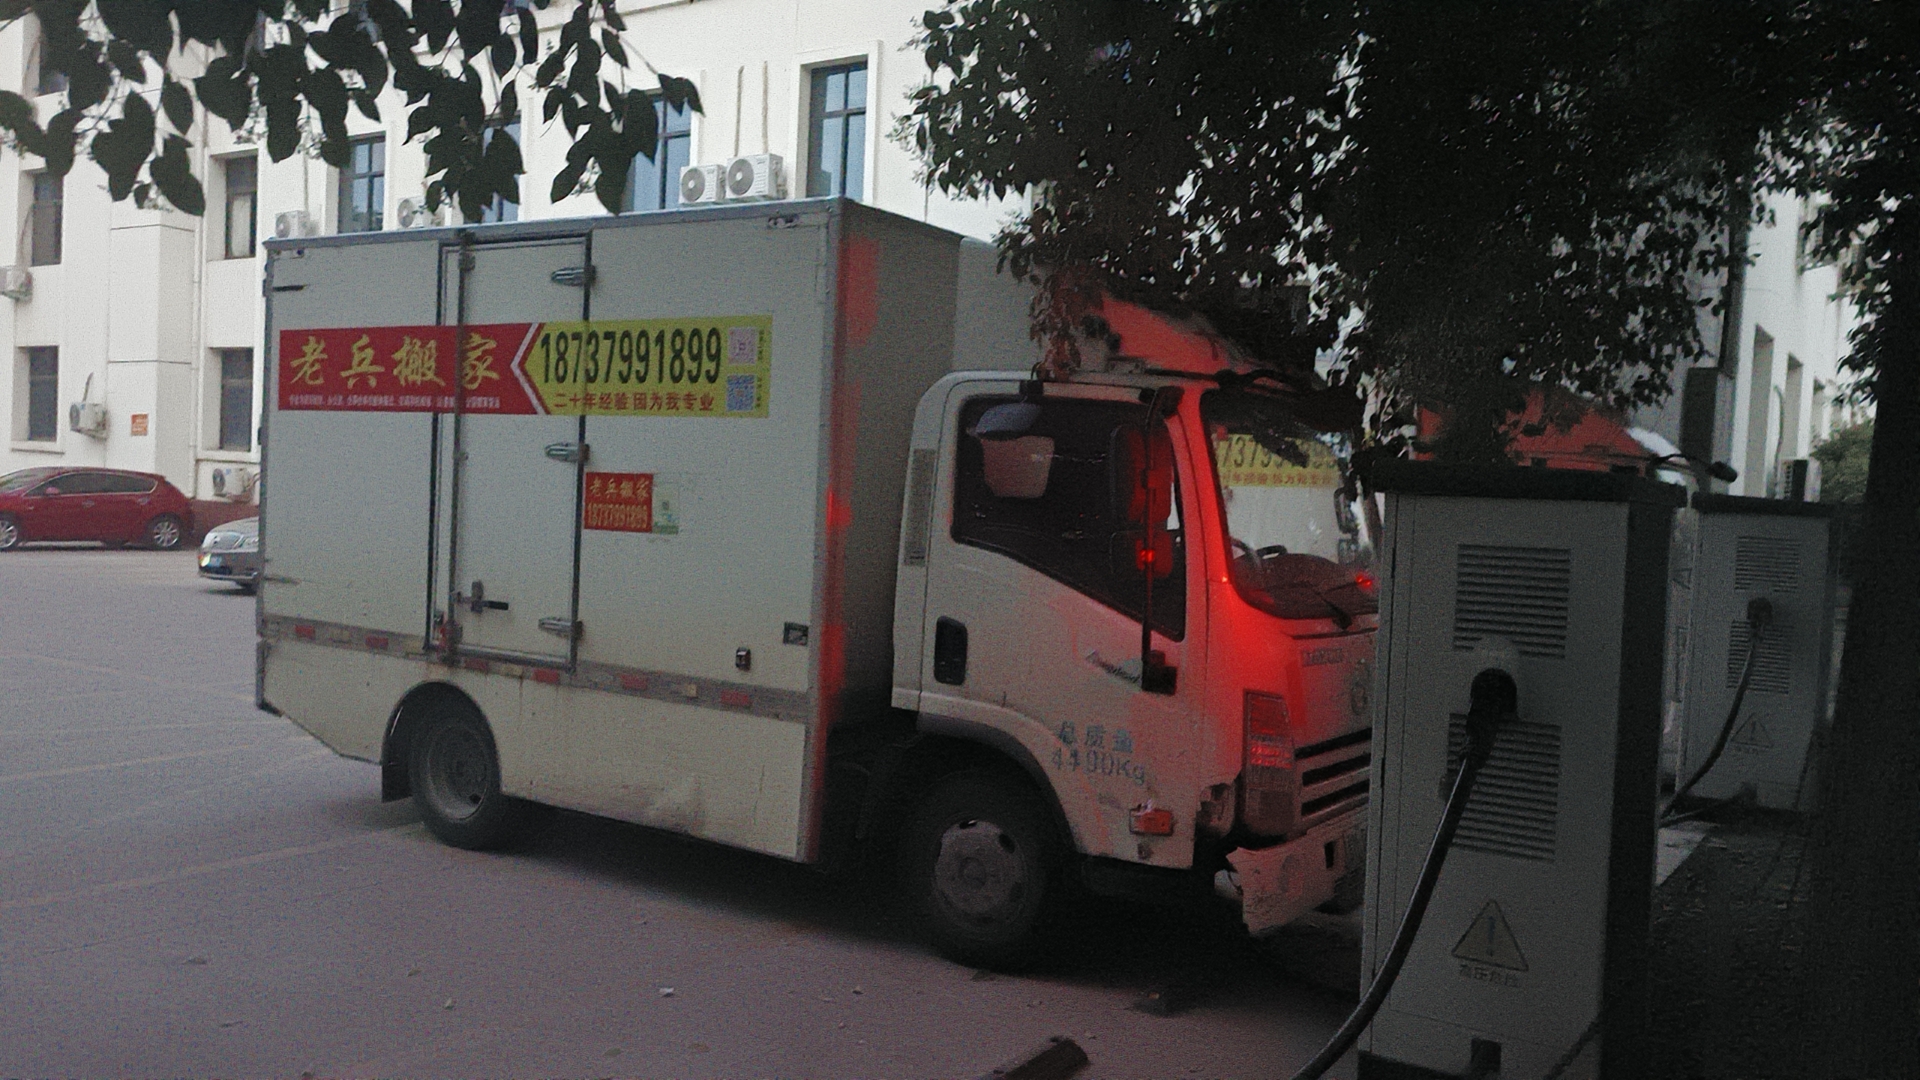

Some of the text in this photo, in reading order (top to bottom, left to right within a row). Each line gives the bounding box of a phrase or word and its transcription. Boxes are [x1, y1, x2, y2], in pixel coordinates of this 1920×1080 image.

[289, 332, 500, 390] 老兵搬家
[540, 327, 722, 385] 18737991899
[554, 391, 714, 411] 二十年经验因为我专业
[589, 477, 649, 501] 老兵搬家
[1059, 720, 1133, 754] 总质量
